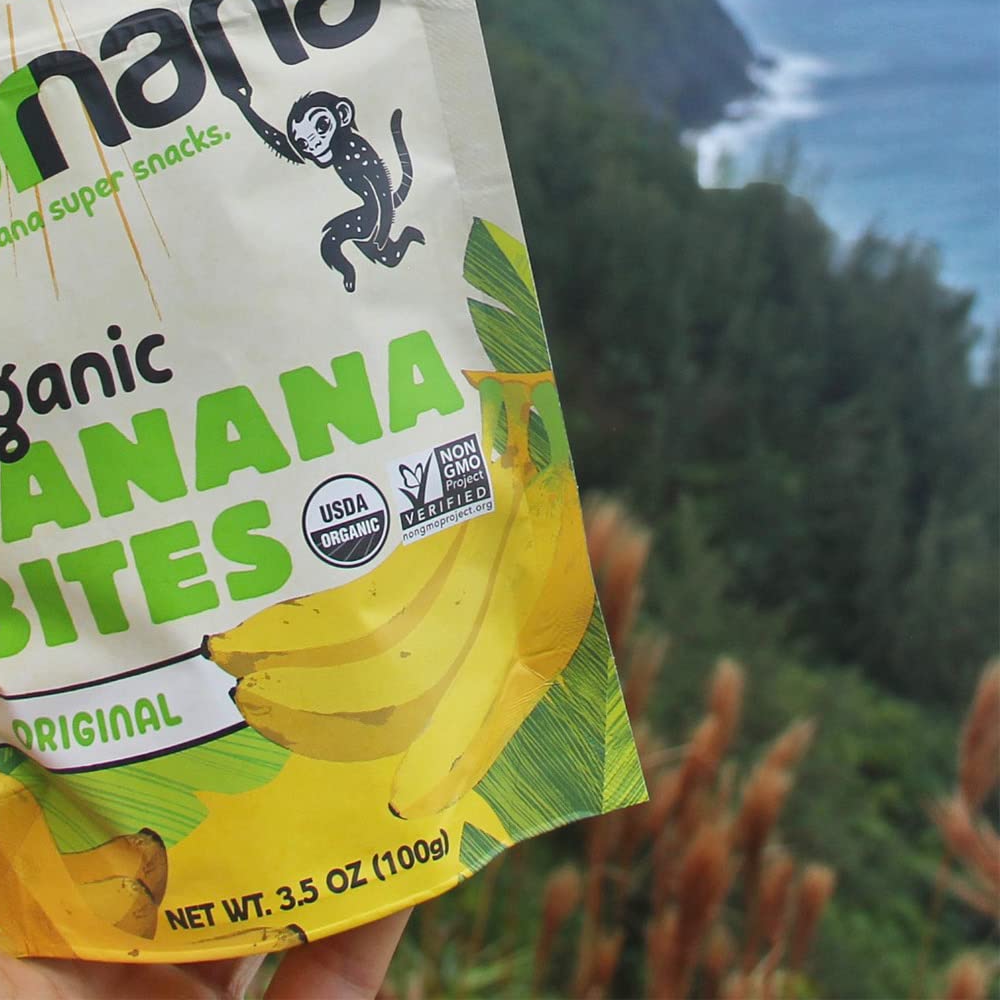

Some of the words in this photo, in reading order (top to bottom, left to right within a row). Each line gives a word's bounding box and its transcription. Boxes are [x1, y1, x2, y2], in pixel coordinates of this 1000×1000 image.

[49, 169, 124, 216] super
[135, 124, 231, 181] snacks.
[440, 440, 476, 464] NON
[444, 455, 480, 478] GMO
[446, 470, 484, 491] Project
[320, 493, 369, 524] USDA
[403, 501, 493, 540] nongmoproject.org
[405, 487, 486, 525] VERIFIED
[321, 517, 380, 548] ORGANIC
[165, 902, 216, 931] NET
[221, 892, 272, 924] WT.
[278, 878, 320, 911] 3.5
[326, 861, 367, 894] OZ
[371, 828, 450, 880] (100g)
